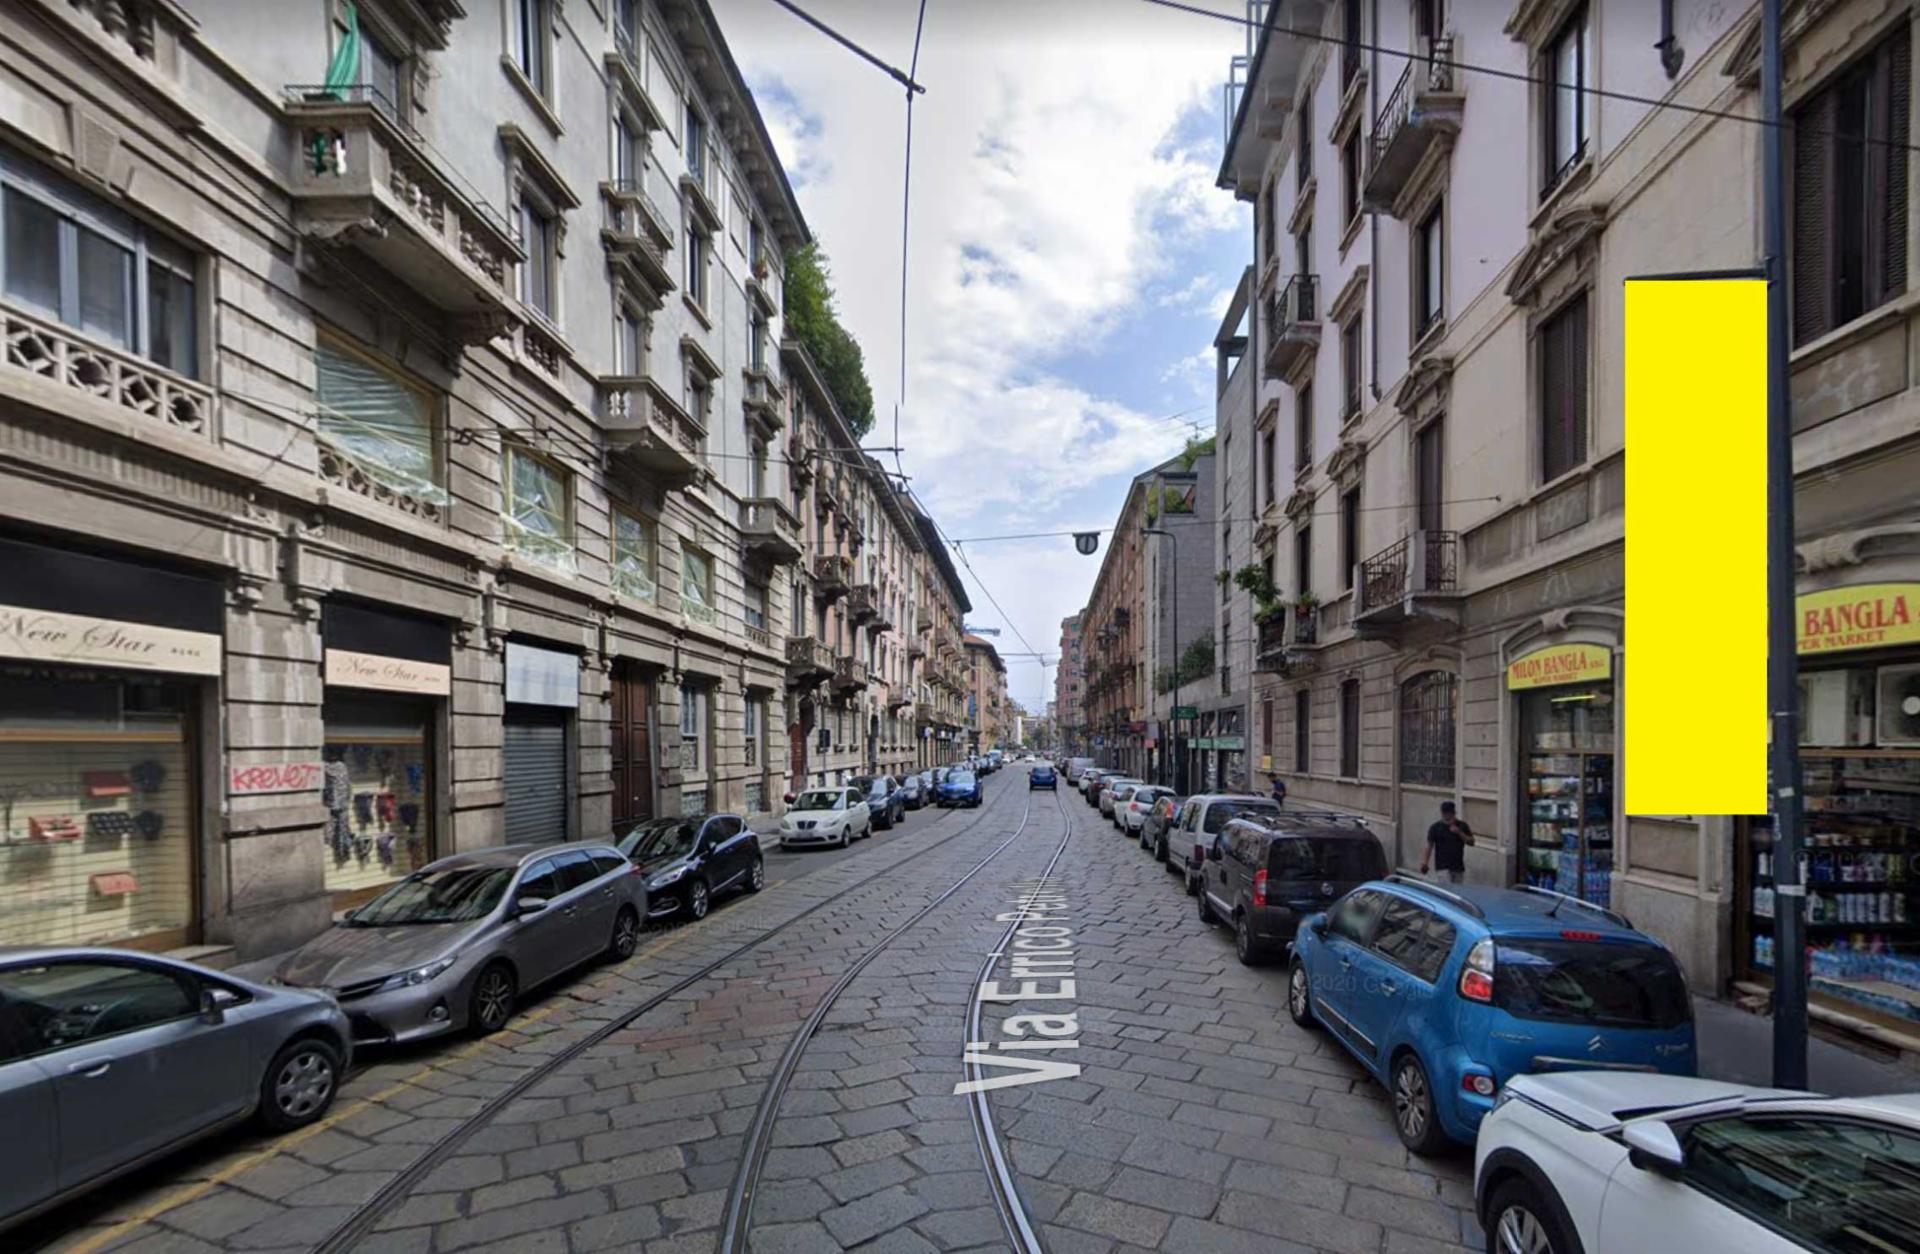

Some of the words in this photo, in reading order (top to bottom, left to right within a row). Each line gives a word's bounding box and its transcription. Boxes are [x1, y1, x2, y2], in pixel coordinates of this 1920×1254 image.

[1804, 595, 1910, 636] BANGLA
[0, 613, 68, 643] New
[82, 624, 156, 654] Star
[1824, 630, 1886, 646] MARKET
[1512, 658, 1541, 680] MILON
[1543, 651, 1587, 675] BANGLA
